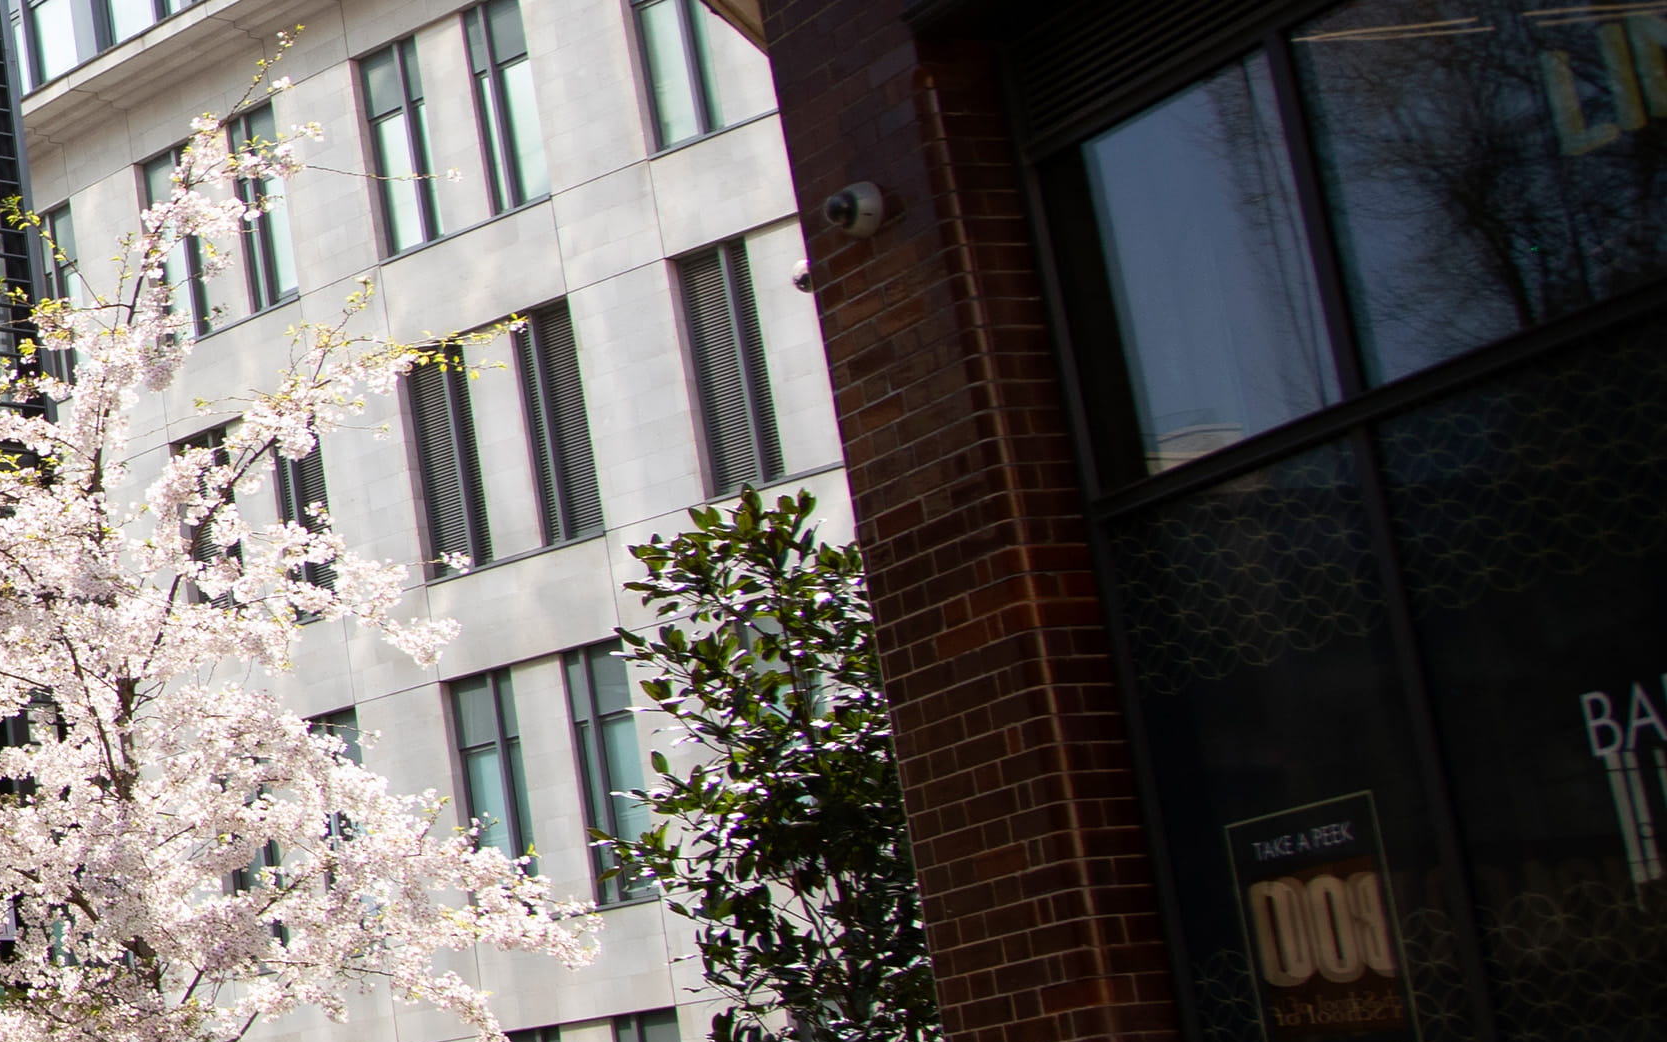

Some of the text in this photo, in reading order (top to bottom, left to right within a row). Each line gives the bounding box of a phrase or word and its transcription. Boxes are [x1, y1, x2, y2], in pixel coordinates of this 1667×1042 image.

[1579, 672, 1667, 758] BA
[1251, 820, 1355, 862] TAKE A PEEK
